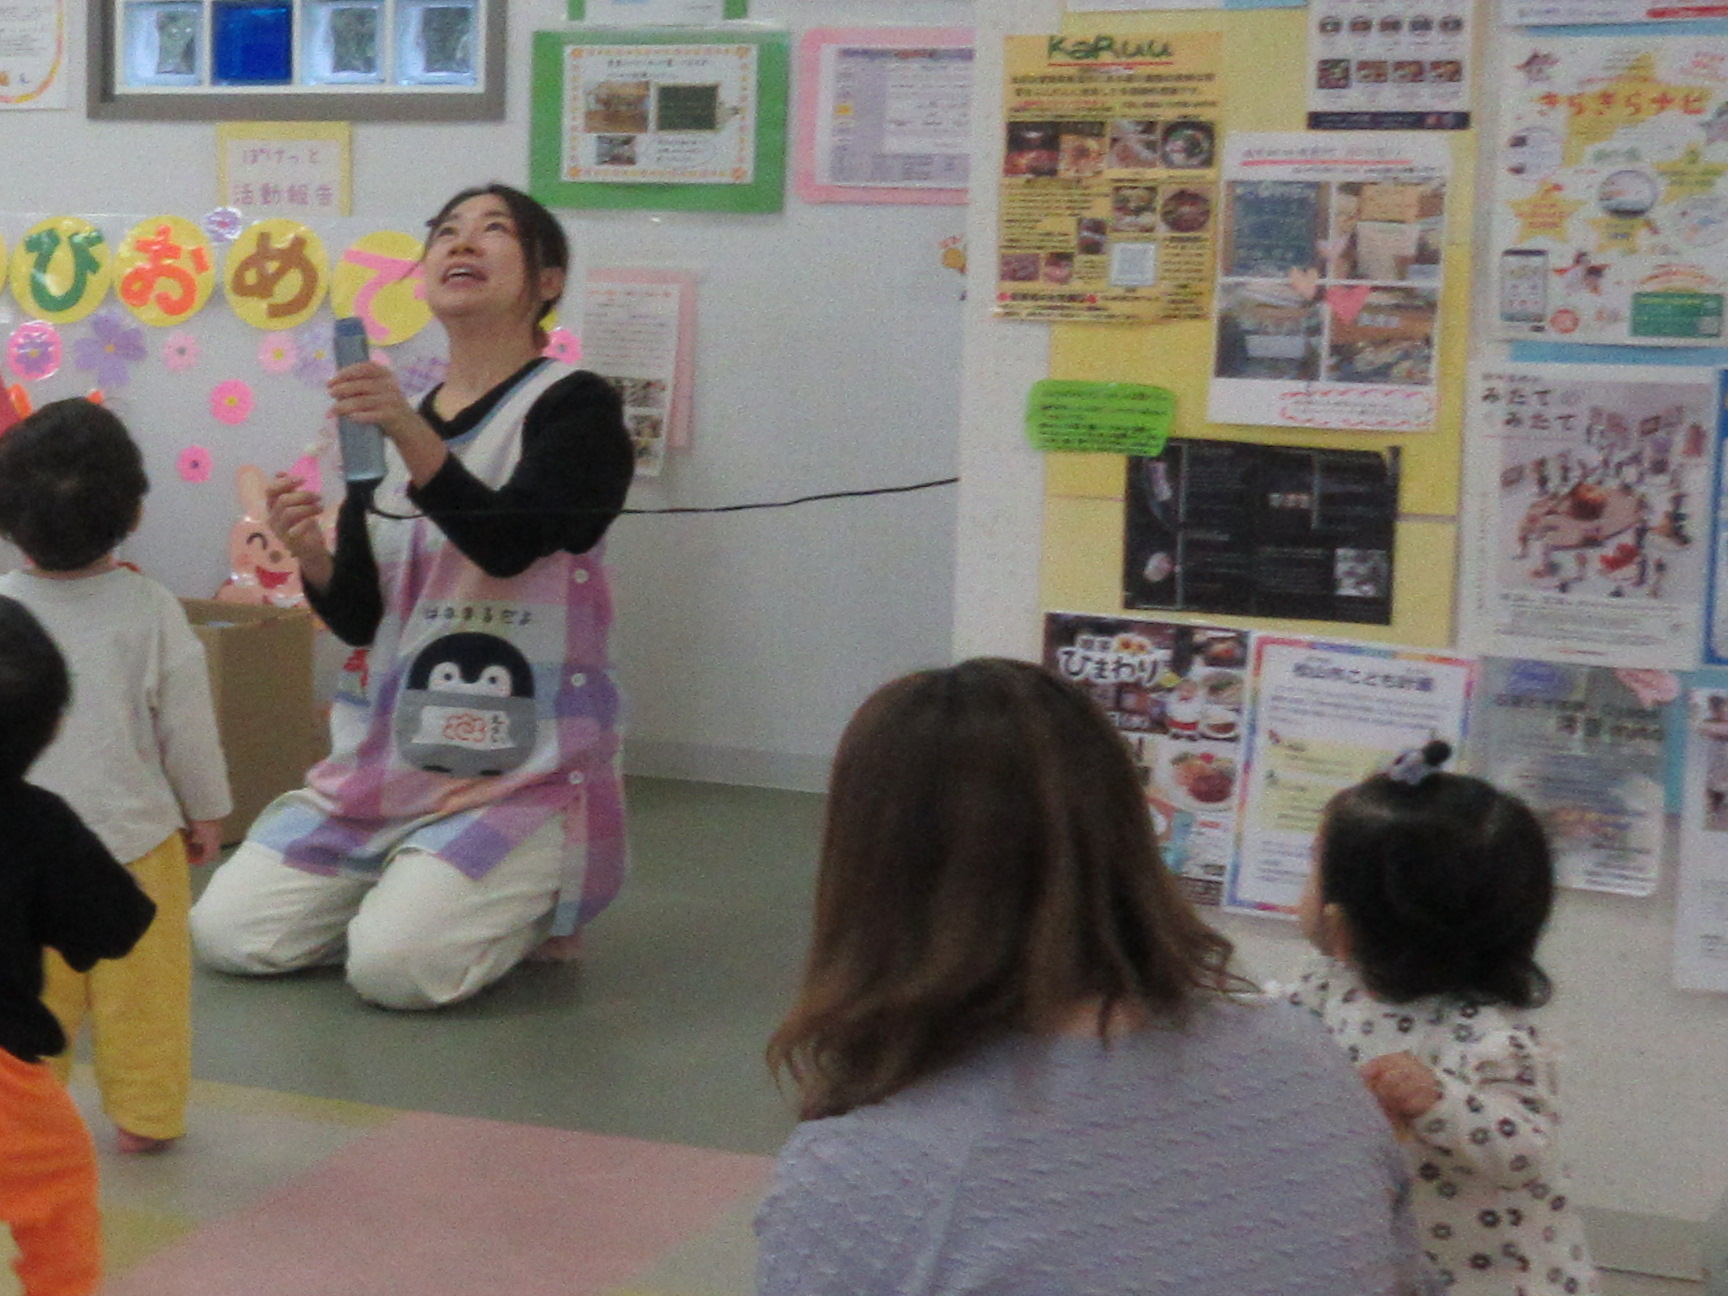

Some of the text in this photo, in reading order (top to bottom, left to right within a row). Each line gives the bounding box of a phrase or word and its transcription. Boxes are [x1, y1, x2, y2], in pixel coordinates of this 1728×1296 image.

[232, 183, 334, 208] 活動報告
[1061, 649, 1157, 684] ひまわり
